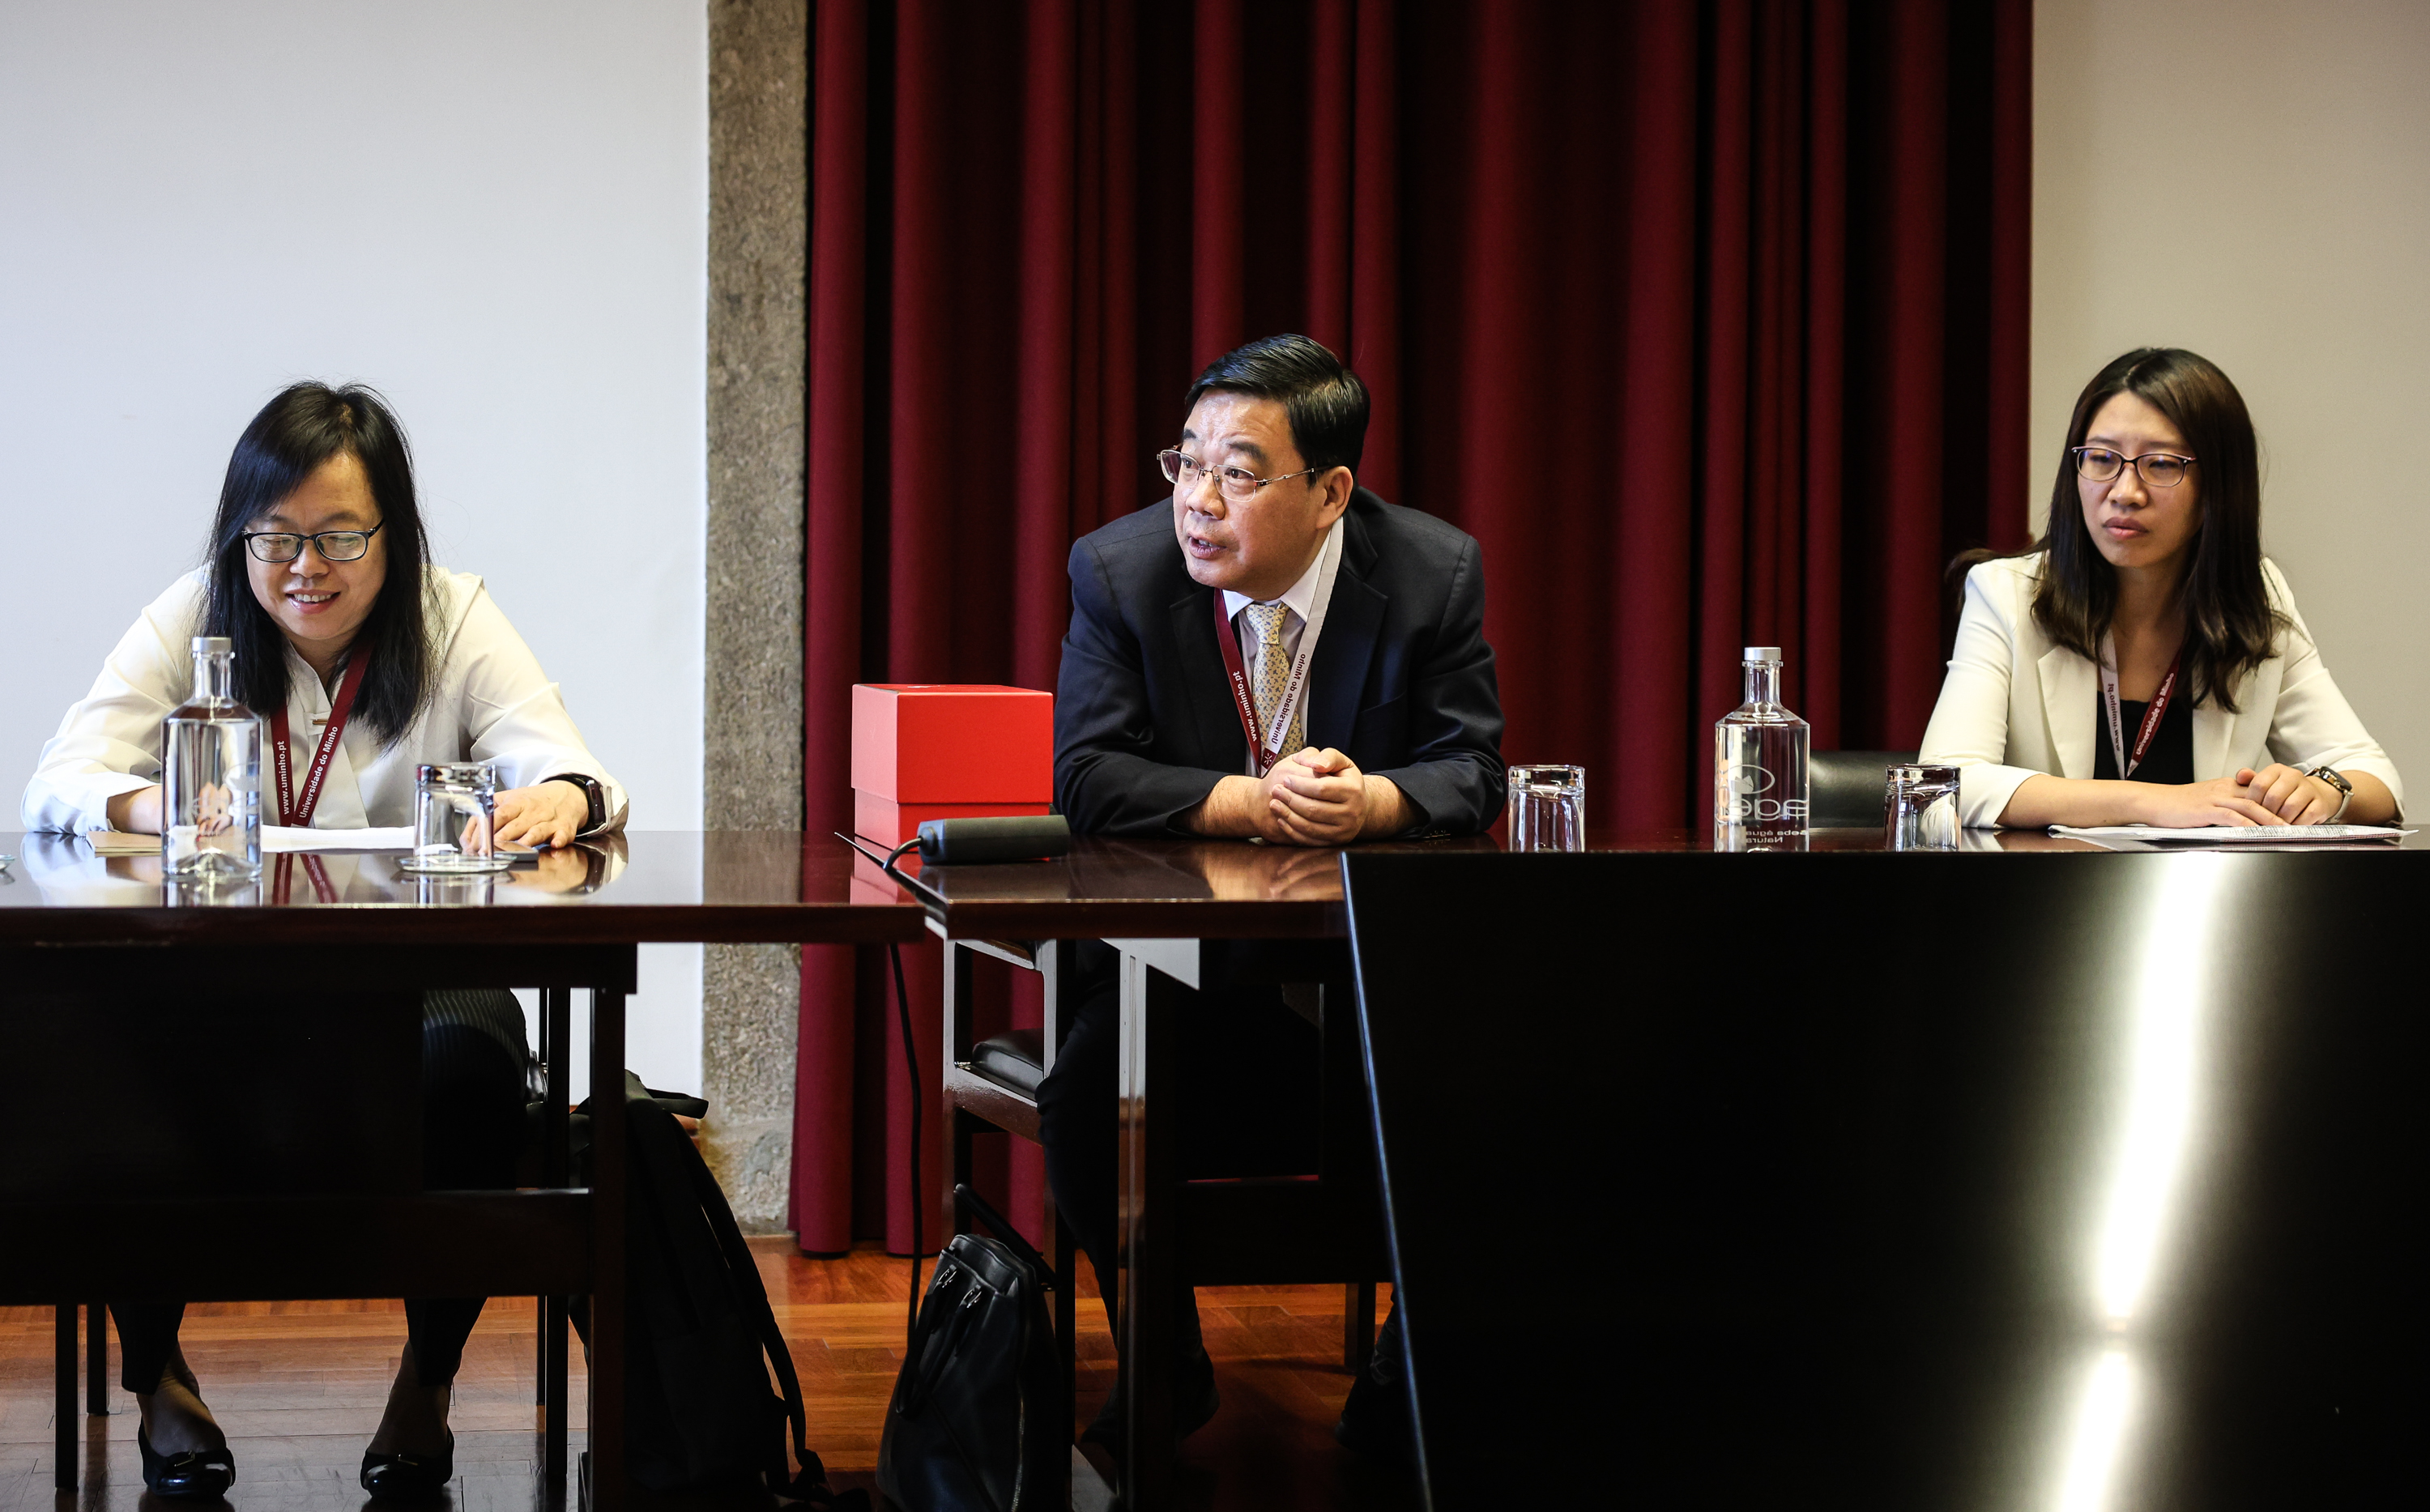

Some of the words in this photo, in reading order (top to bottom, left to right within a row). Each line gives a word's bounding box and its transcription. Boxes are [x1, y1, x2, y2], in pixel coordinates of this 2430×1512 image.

[1233, 671, 1257, 742] www.uminho.pt
[2136, 708, 2160, 755] Universidade
[2155, 697, 2164, 707] do
[321, 753, 328, 765] do
[322, 726, 339, 753] Minho
[276, 740, 290, 815] www.uminho.pt
[299, 765, 323, 818] Universidade
